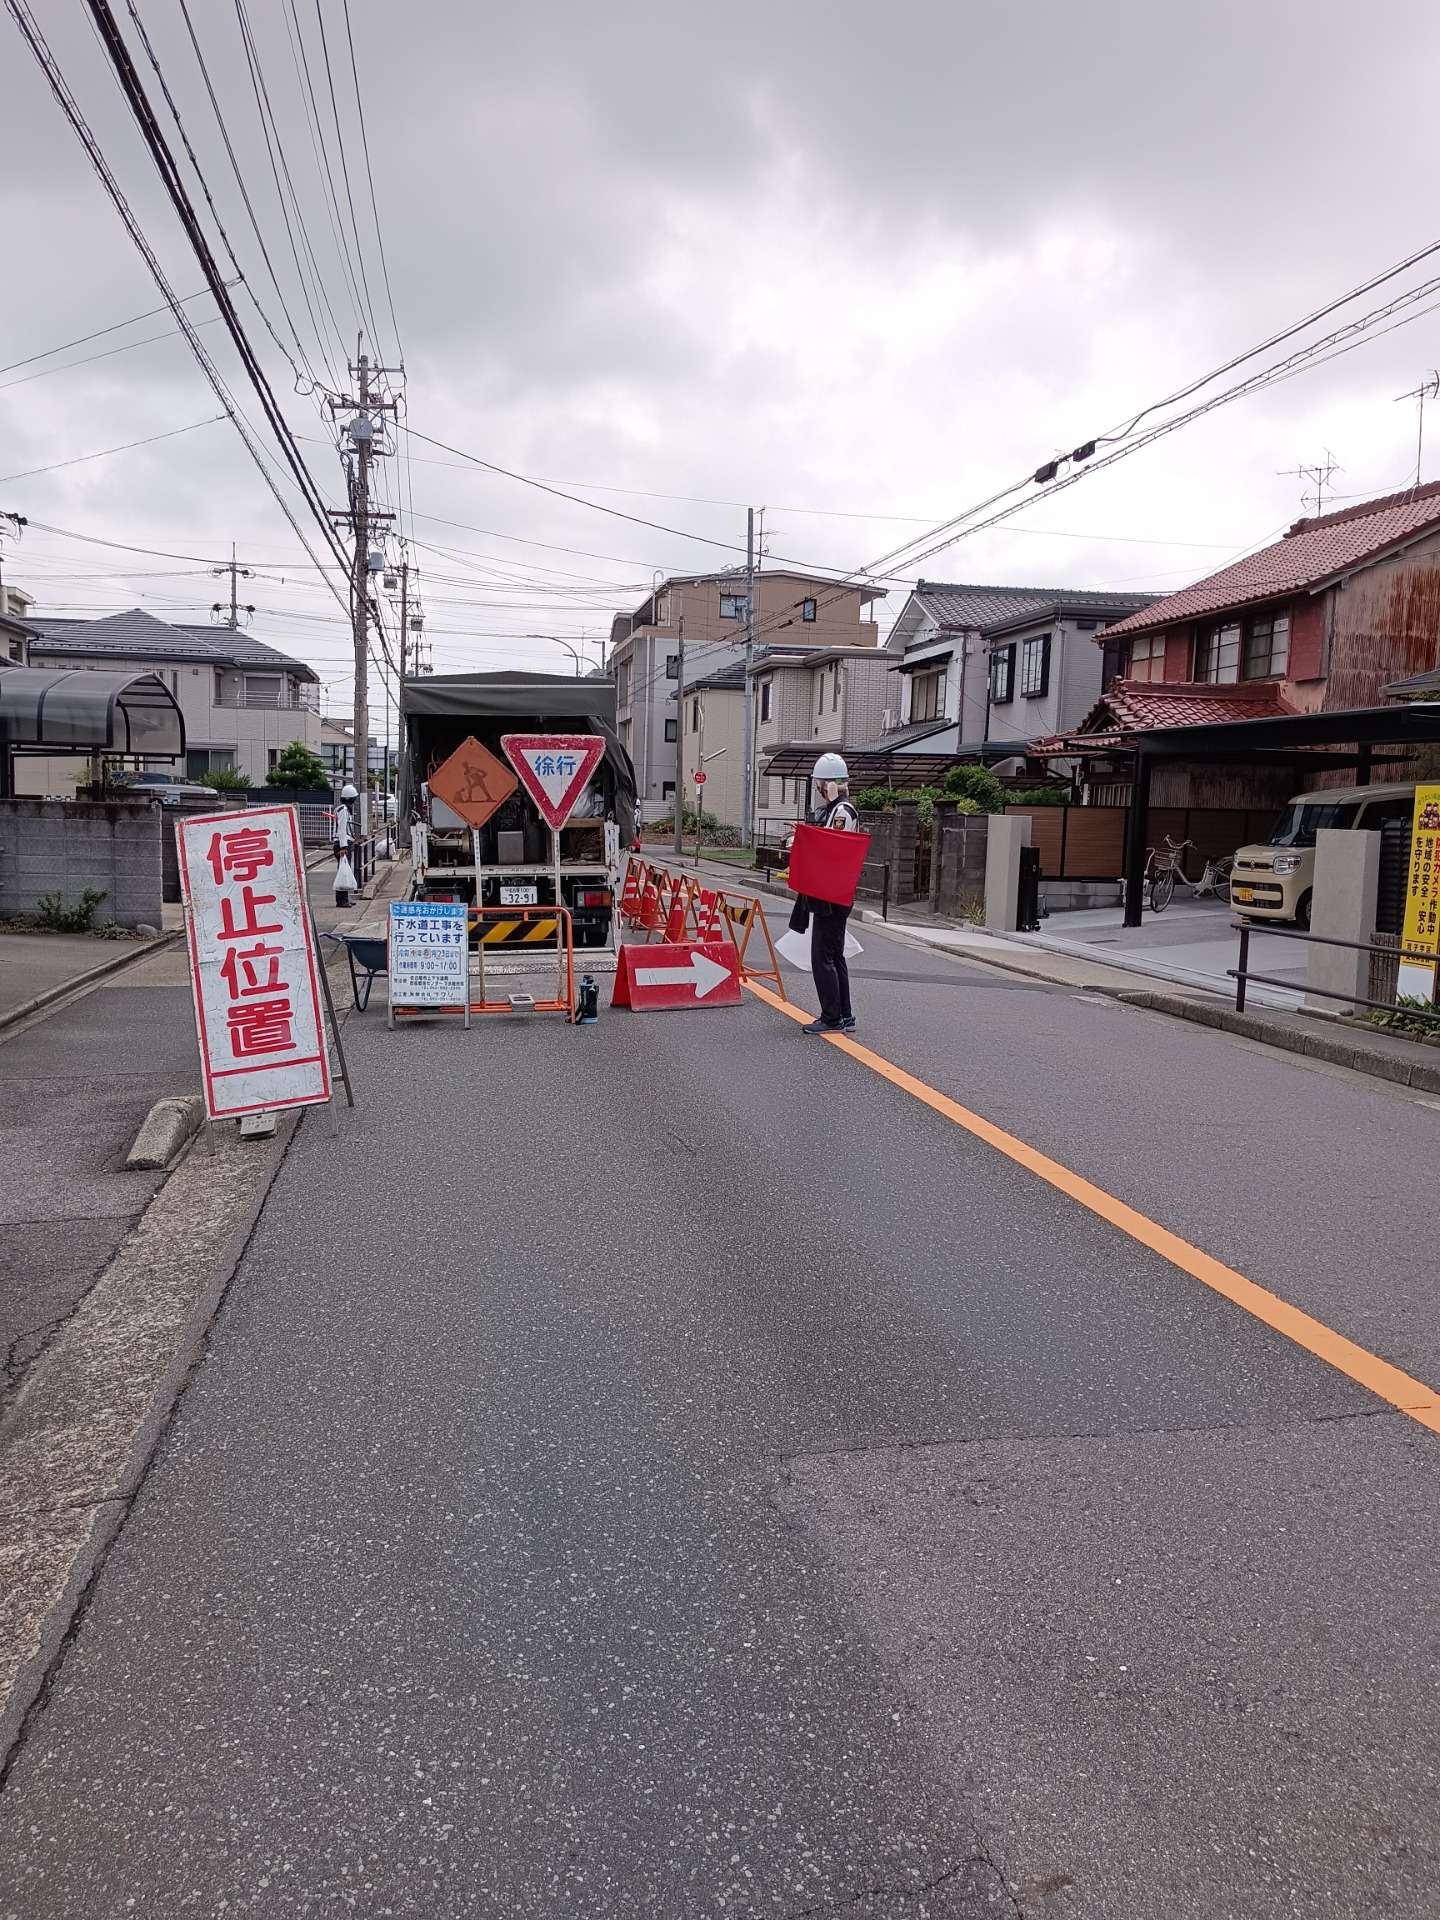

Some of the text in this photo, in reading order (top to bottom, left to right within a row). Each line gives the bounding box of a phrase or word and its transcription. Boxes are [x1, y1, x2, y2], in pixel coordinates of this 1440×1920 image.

[534, 755, 577, 776] 徐行
[1411, 837, 1423, 896] を守ります
[1417, 837, 1434, 934] 地域の安全・安心
[508, 893, 534, 904] 32-91
[393, 905, 465, 915] ご迷惑をおかけします
[394, 919, 463, 931] 下水道工事を
[206, 828, 297, 1058] 停止位置
[394, 931, 463, 944] 行っています
